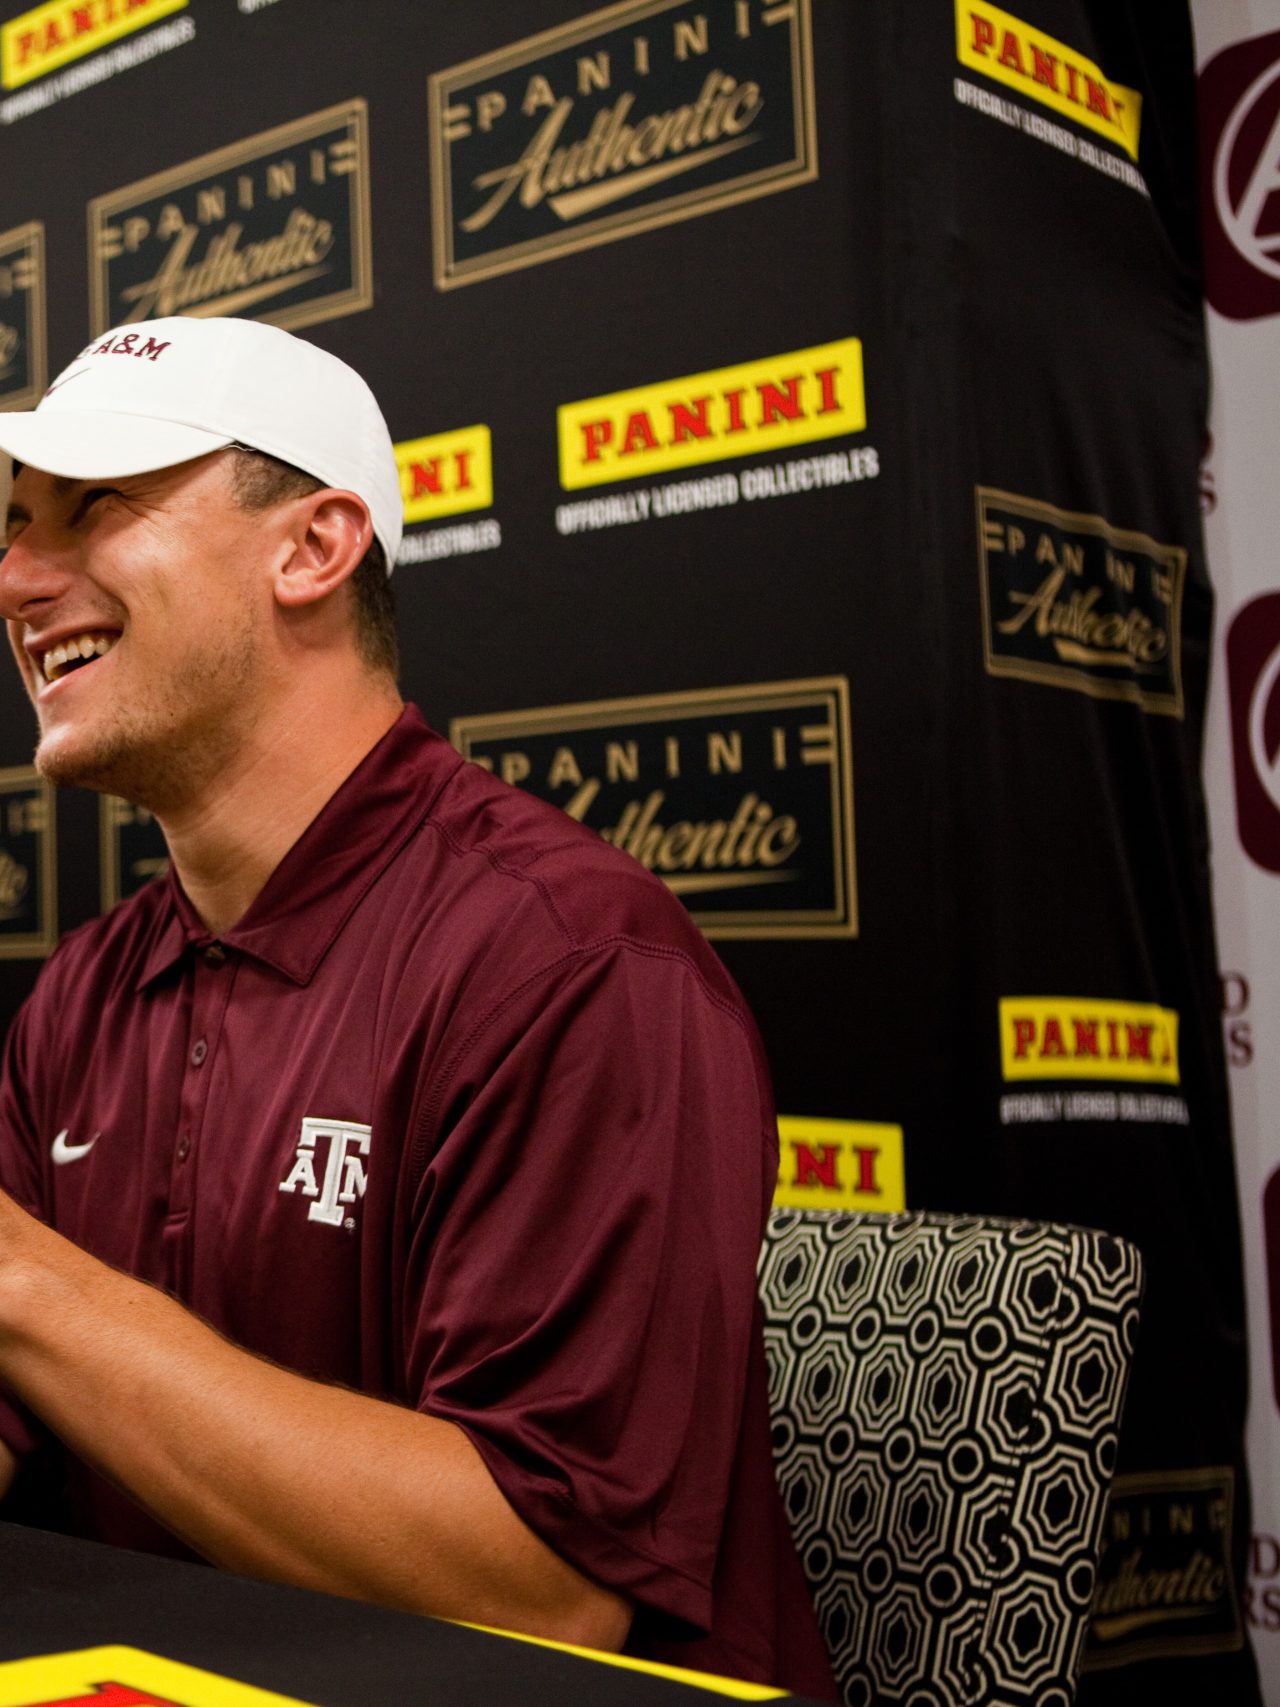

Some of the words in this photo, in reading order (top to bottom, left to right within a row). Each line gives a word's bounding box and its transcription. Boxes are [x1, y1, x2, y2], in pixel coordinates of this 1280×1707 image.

[476, 0, 750, 133] PANINI
[459, 69, 765, 233] Authentic
[122, 149, 327, 253] PANINI
[120, 206, 335, 324] Authentic
[91, 333, 172, 361] A&M
[579, 366, 842, 464] PANINI
[406, 448, 476, 502] NI
[555, 488, 650, 535] OFFICIALLY
[651, 472, 738, 518] LICENSED
[739, 446, 880, 502] COLLECTIBLES
[500, 727, 787, 790] PANINI
[786, 1140, 883, 1196] NI
